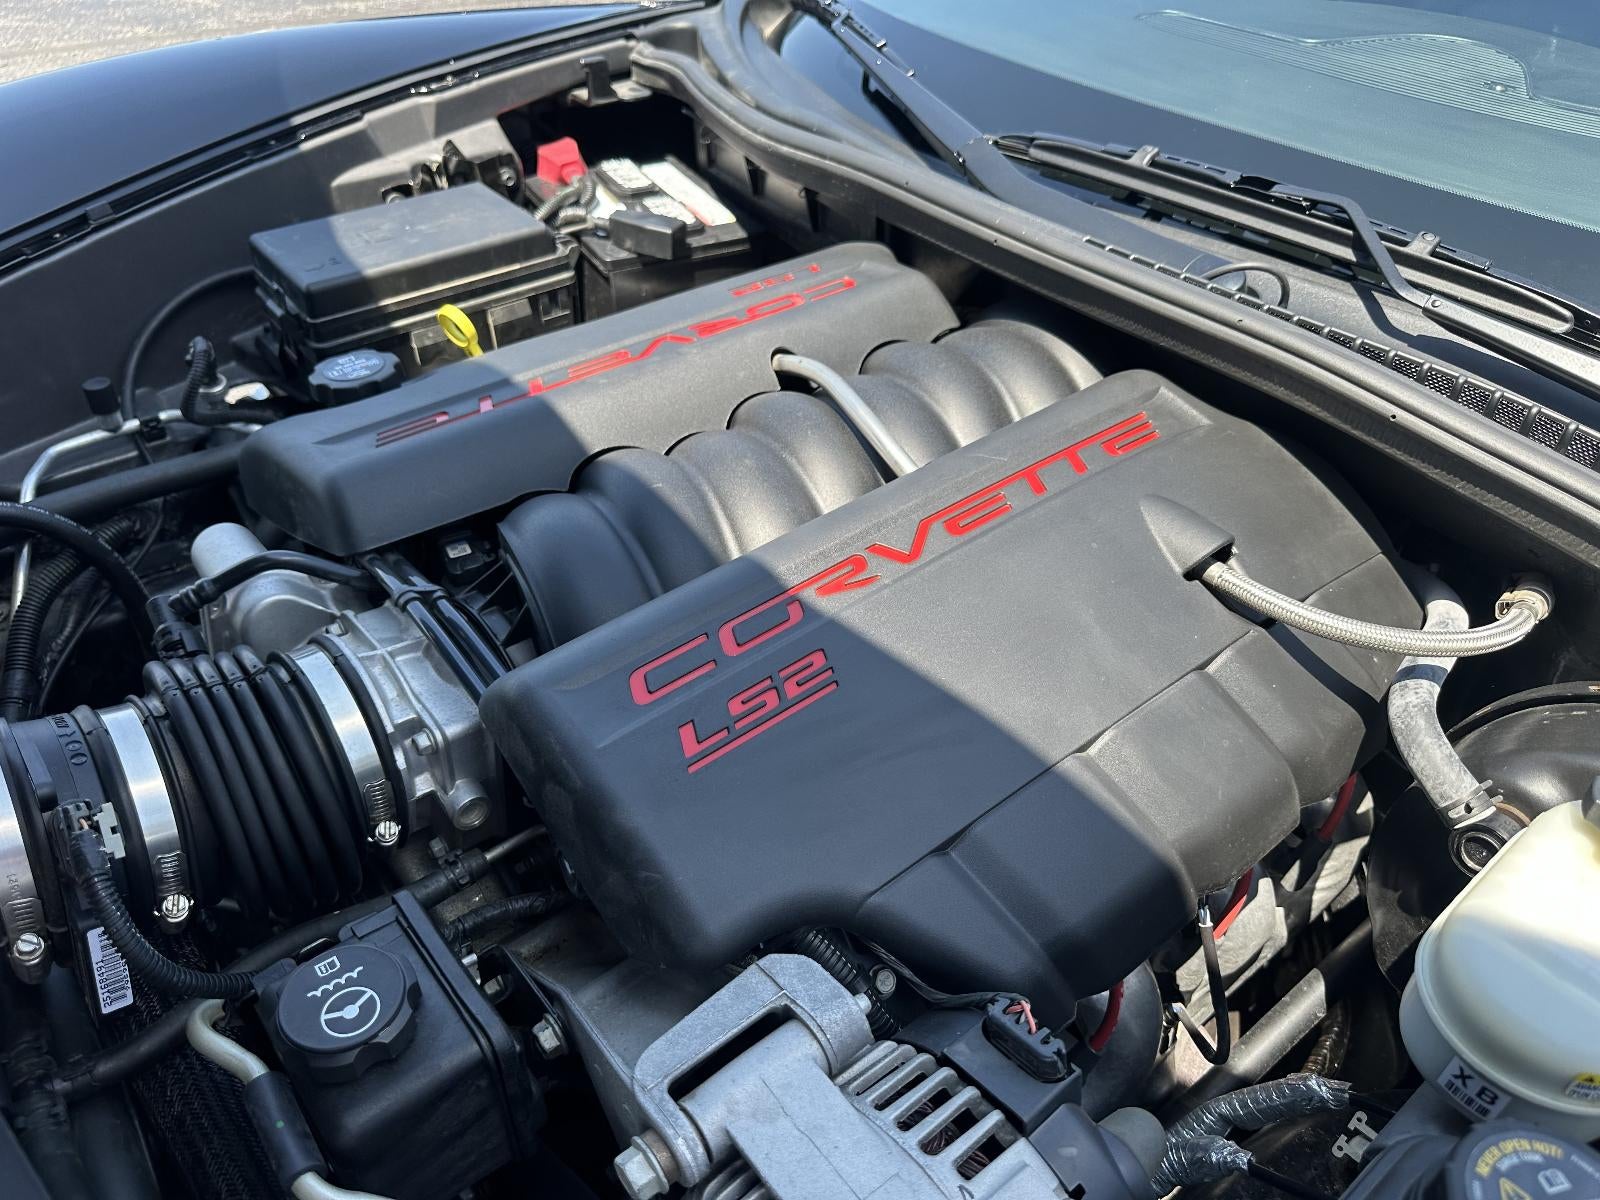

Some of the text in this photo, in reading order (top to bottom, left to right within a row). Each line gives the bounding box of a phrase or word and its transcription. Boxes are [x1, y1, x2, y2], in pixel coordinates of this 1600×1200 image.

[375, 275, 857, 448] CORVETTE
[628, 411, 1161, 707] CORVETTE
[677, 648, 835, 760] LS2
